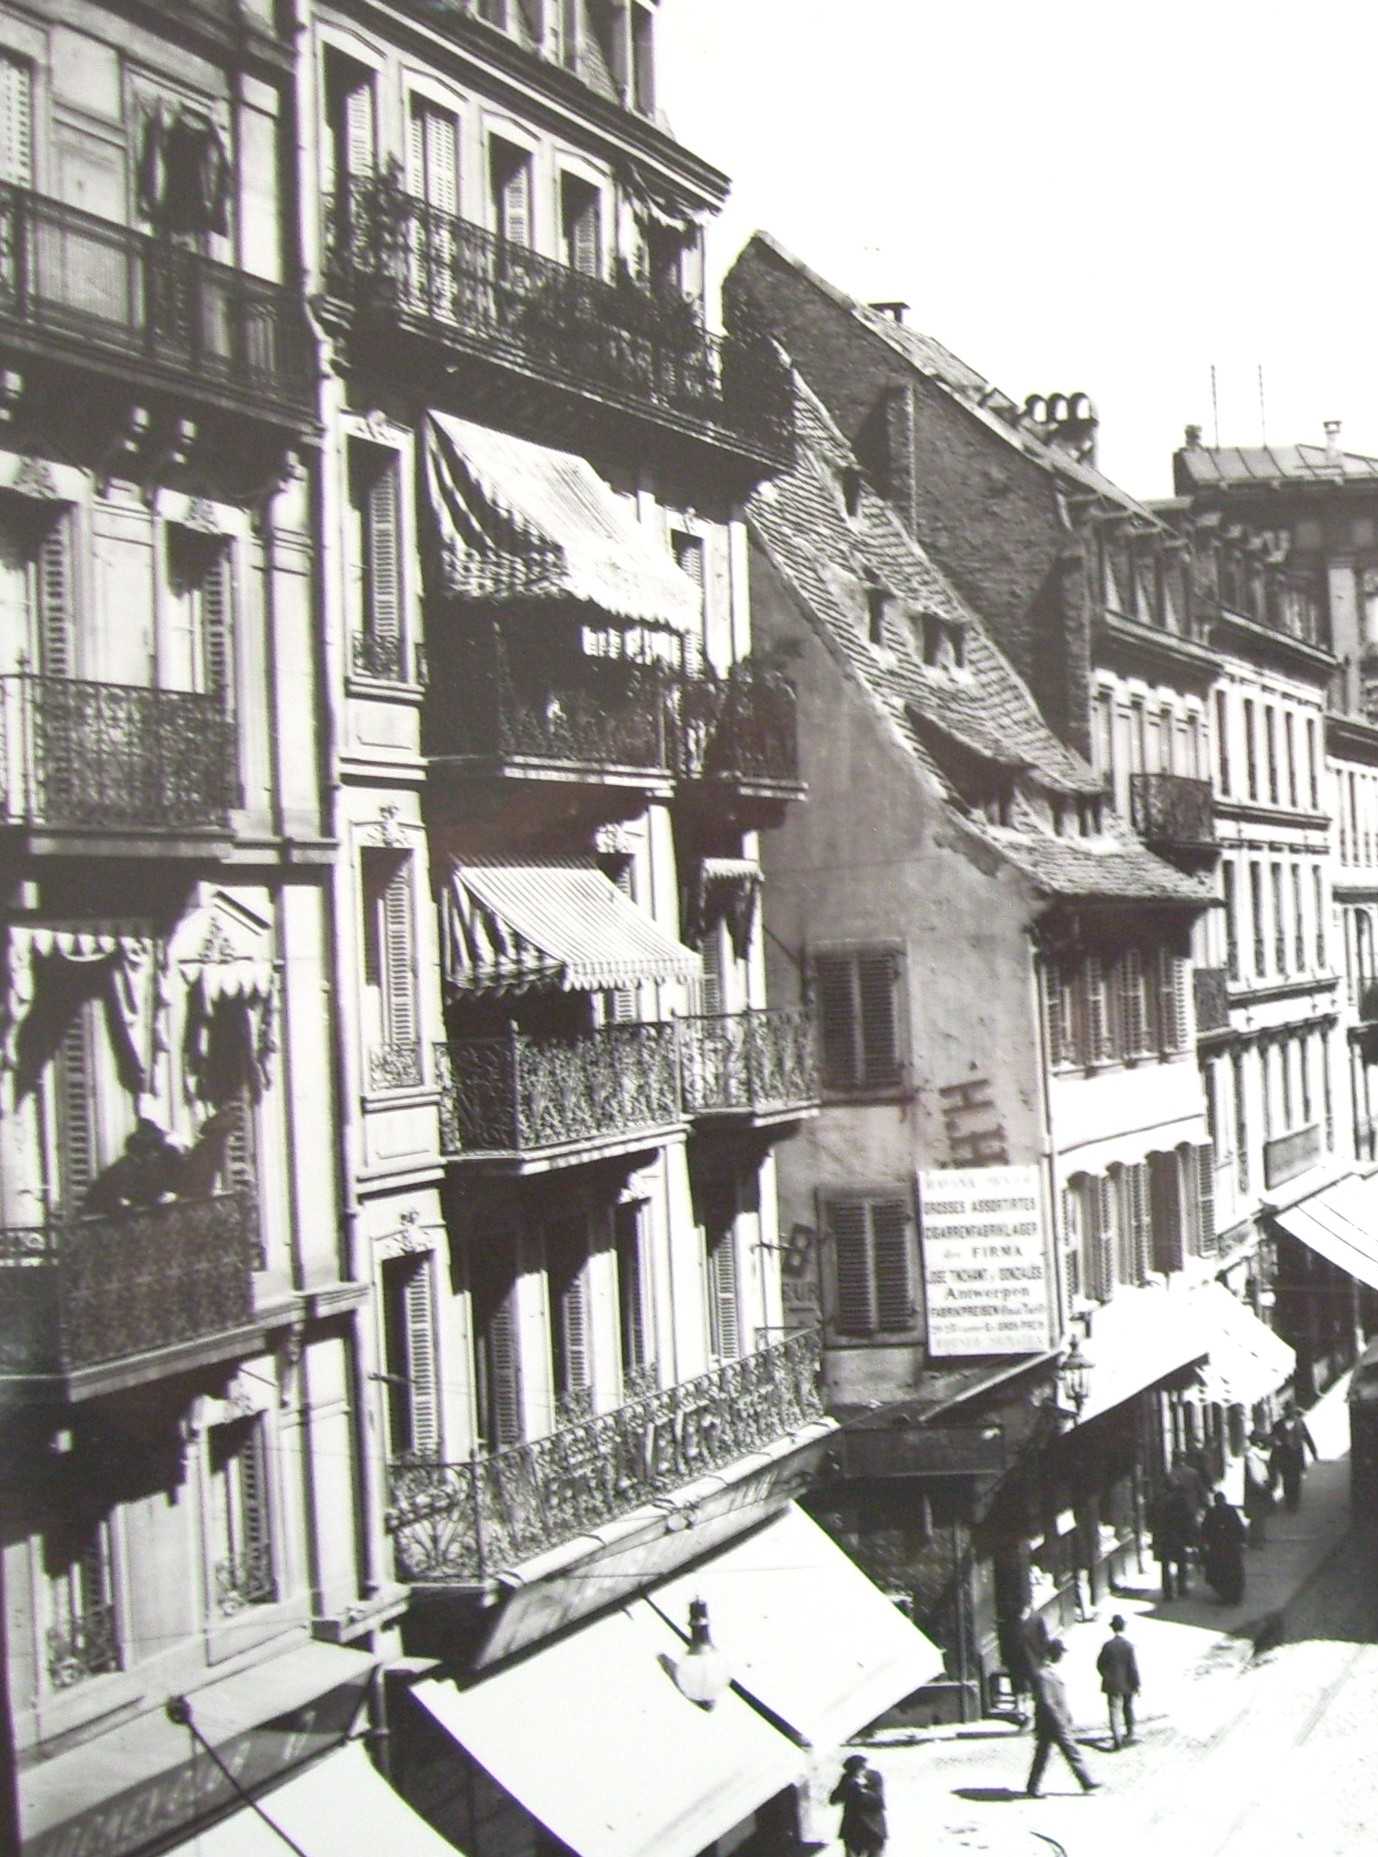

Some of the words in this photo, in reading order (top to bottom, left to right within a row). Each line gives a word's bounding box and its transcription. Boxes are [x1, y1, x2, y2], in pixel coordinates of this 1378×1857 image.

[924, 1200, 965, 1215] GROSSES
[972, 1246, 1023, 1259] FIRMA
[946, 1286, 1030, 1302] Antwerpen
